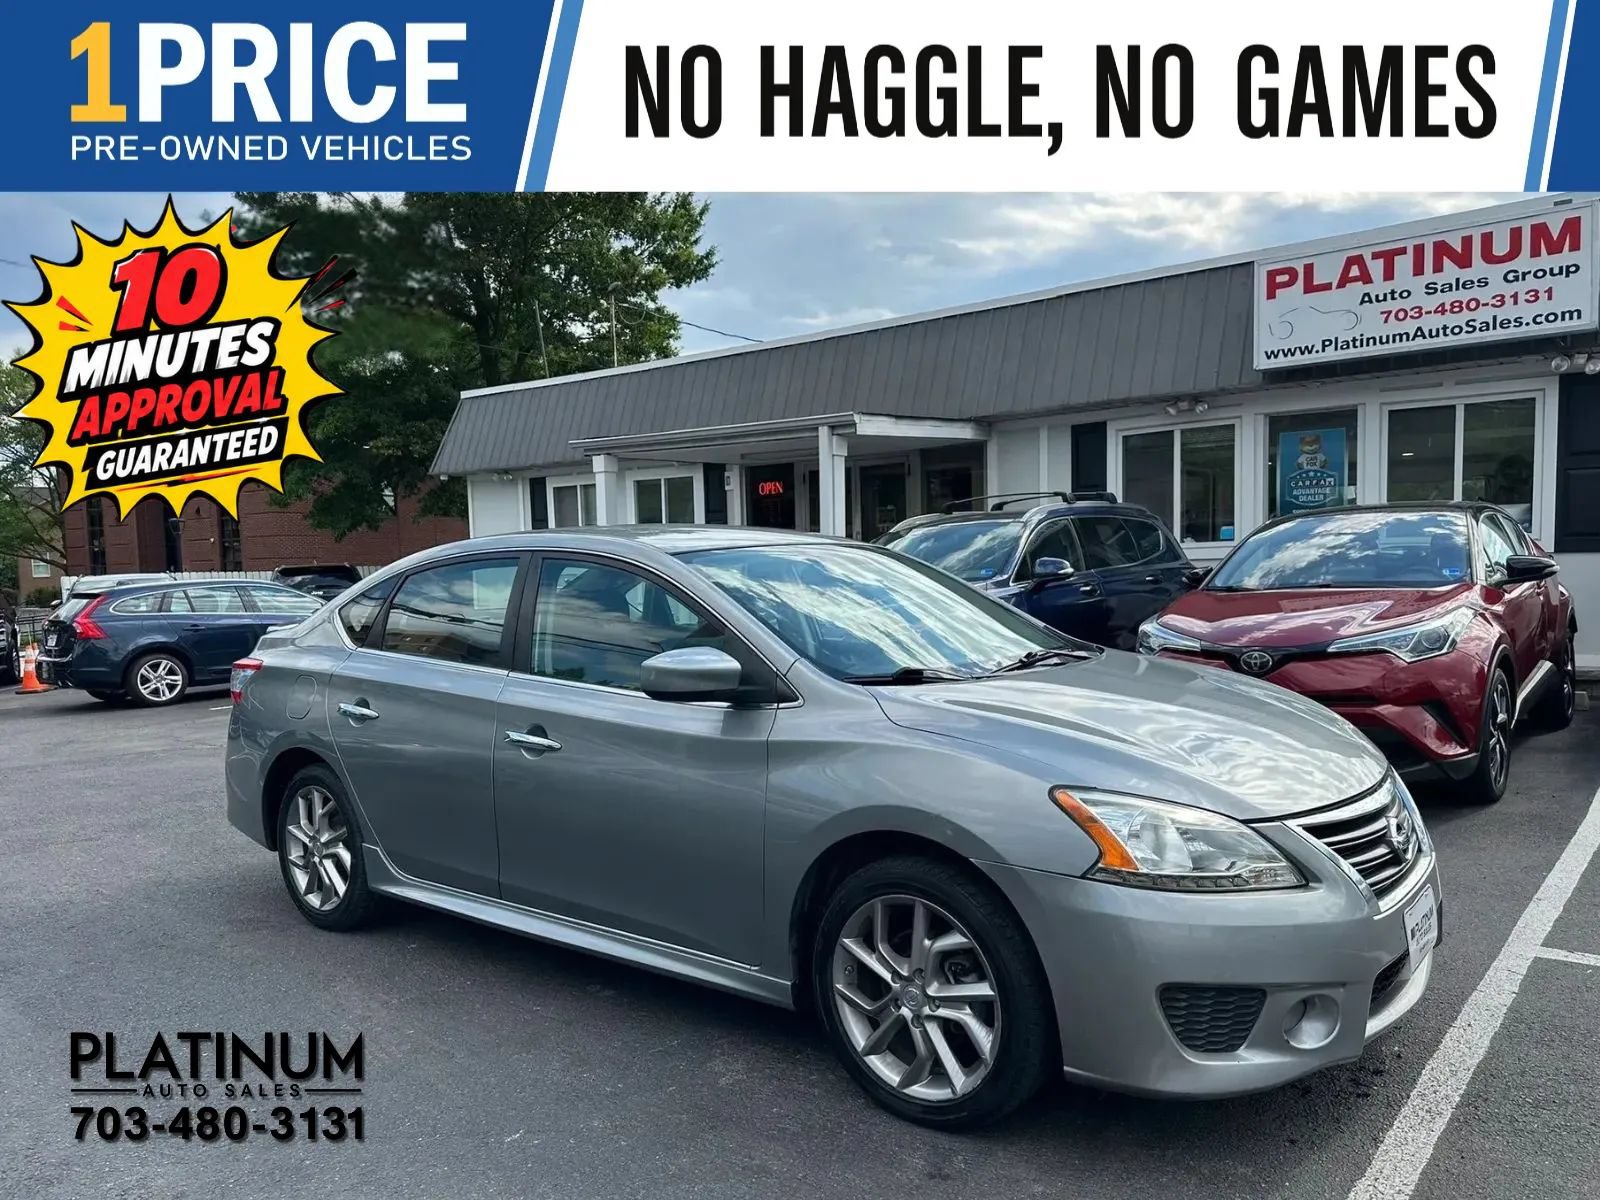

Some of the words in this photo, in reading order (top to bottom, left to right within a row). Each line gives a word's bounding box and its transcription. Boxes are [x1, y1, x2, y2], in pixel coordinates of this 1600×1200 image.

[1266, 215, 1582, 300] PLATINUM
[1359, 287, 1412, 306] Auto
[1424, 275, 1490, 297] Sales
[1502, 262, 1581, 285] Group
[1380, 286, 1554, 324] 703-480-3131
[1264, 307, 1583, 361] www.PlatinumAutoSales.com
[758, 481, 784, 496] OPEN
[1290, 478, 1335, 488] CARFAX
[1292, 486, 1332, 496] ADVANTAGE
[1298, 493, 1325, 502] DEALER
